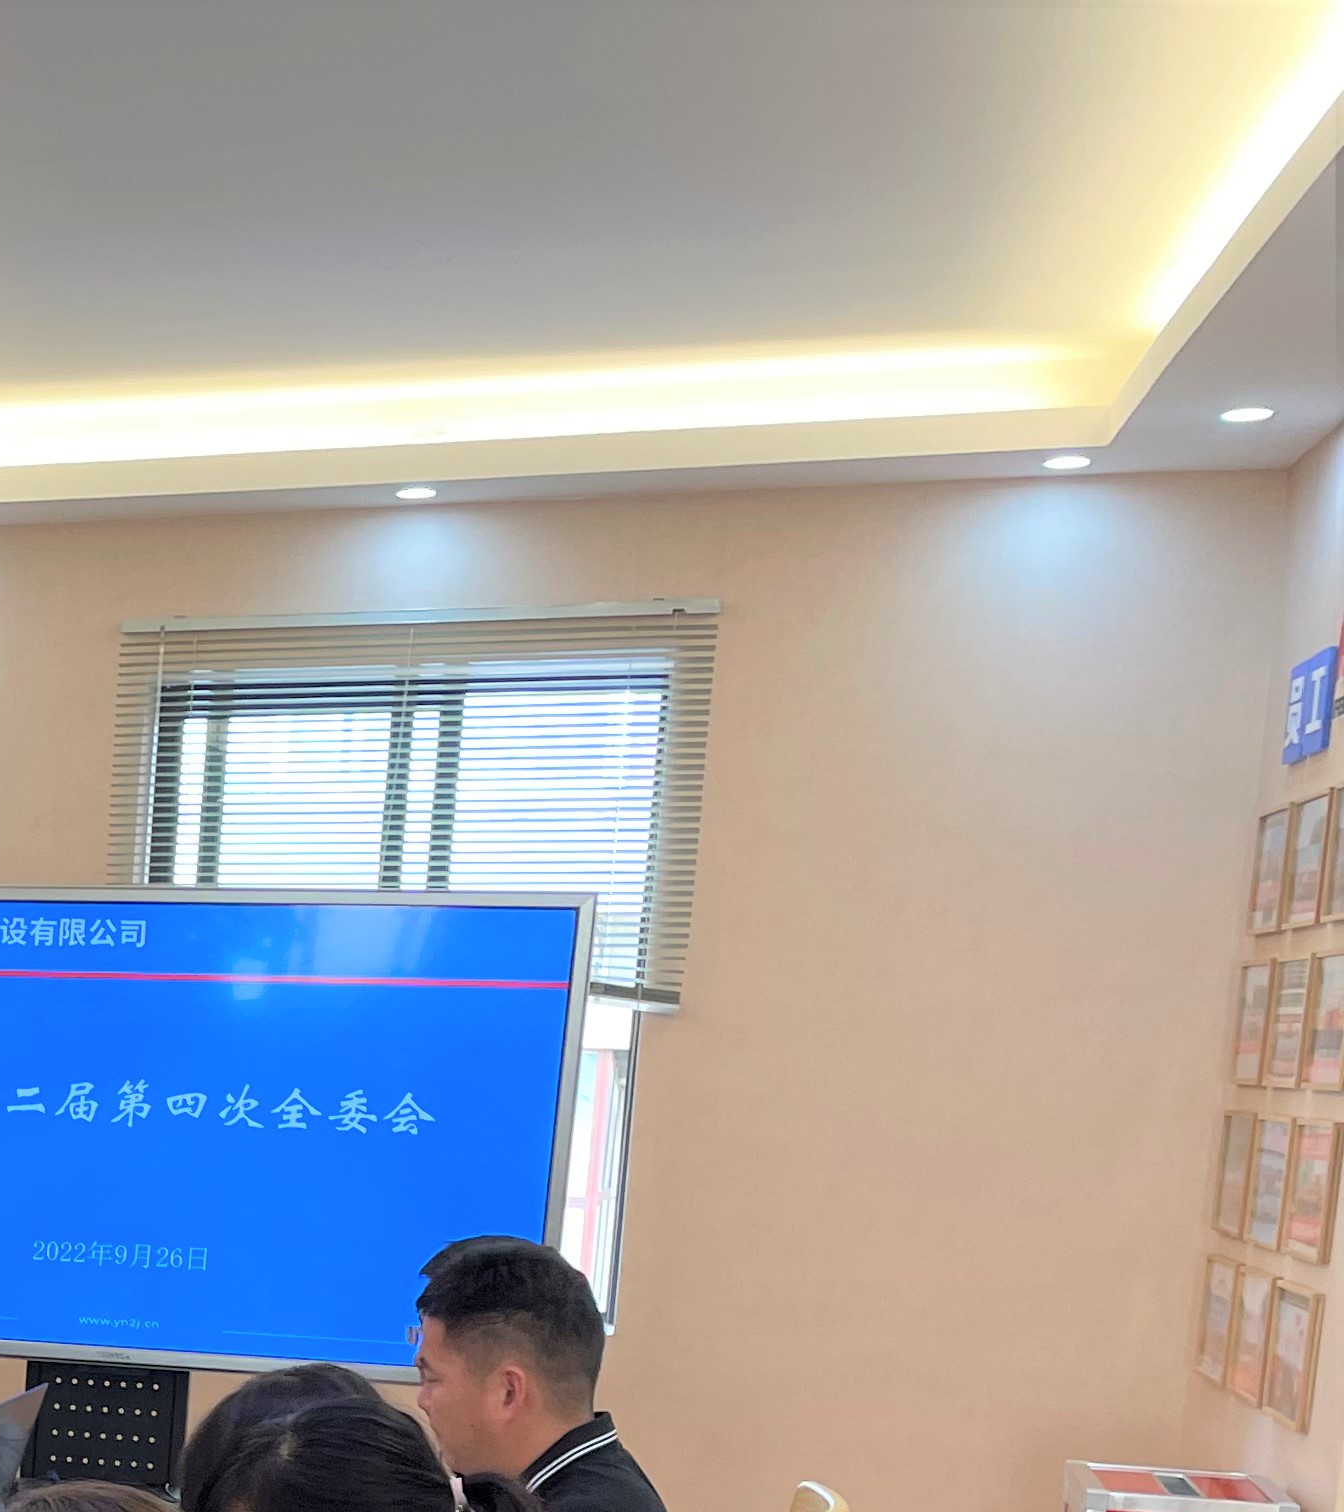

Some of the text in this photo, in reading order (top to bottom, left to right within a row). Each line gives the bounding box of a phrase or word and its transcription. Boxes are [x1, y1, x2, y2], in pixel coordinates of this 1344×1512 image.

[32, 1240, 208, 1271] 2022年9月26日
[79, 1315, 160, 1330] www.yn2j.cn
